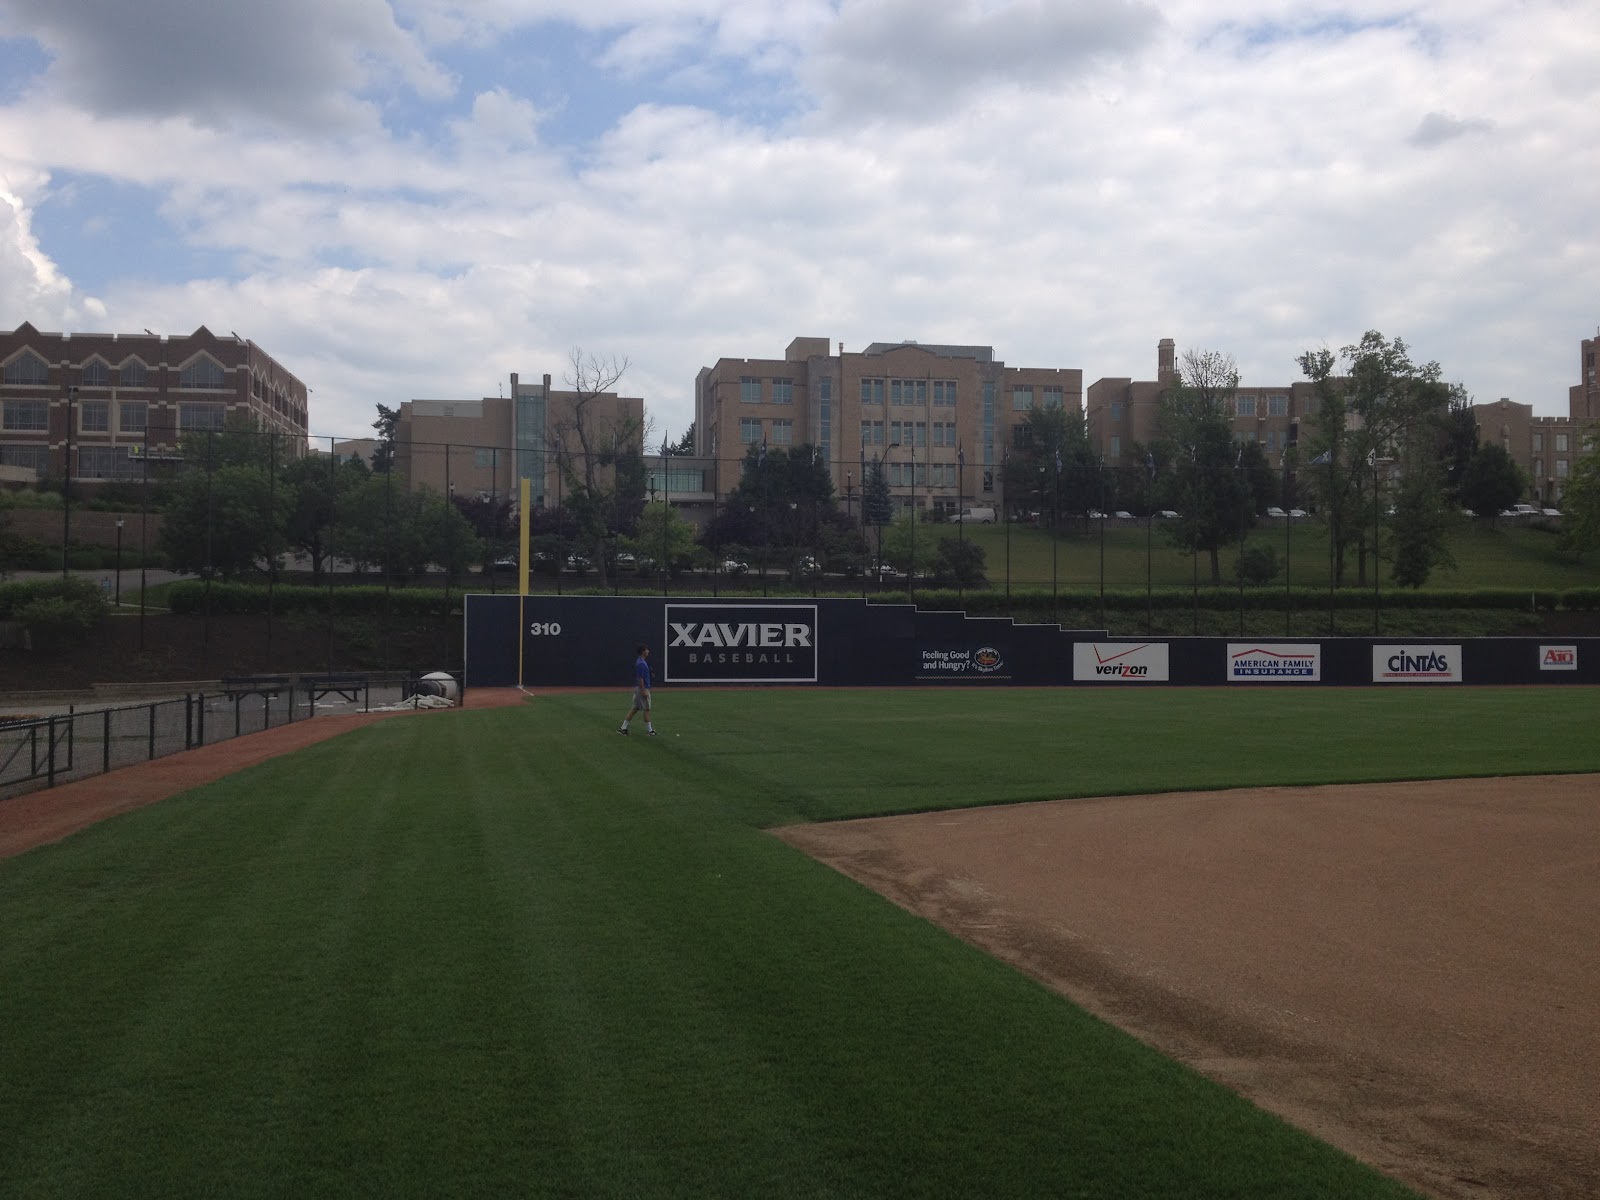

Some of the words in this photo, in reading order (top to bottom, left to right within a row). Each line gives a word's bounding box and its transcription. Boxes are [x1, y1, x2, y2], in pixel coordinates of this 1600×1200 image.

[530, 622, 562, 636] 310
[668, 622, 812, 647] XAVIER
[689, 653, 793, 663] BASEBALL
[922, 650, 949, 661] Feeling
[949, 650, 970, 659] Good
[922, 660, 937, 670] and
[938, 660, 971, 672] Hungry?
[1095, 662, 1148, 678] verizon
[1234, 660, 1279, 668] AMERICAN
[1283, 660, 1314, 668] FAMILY
